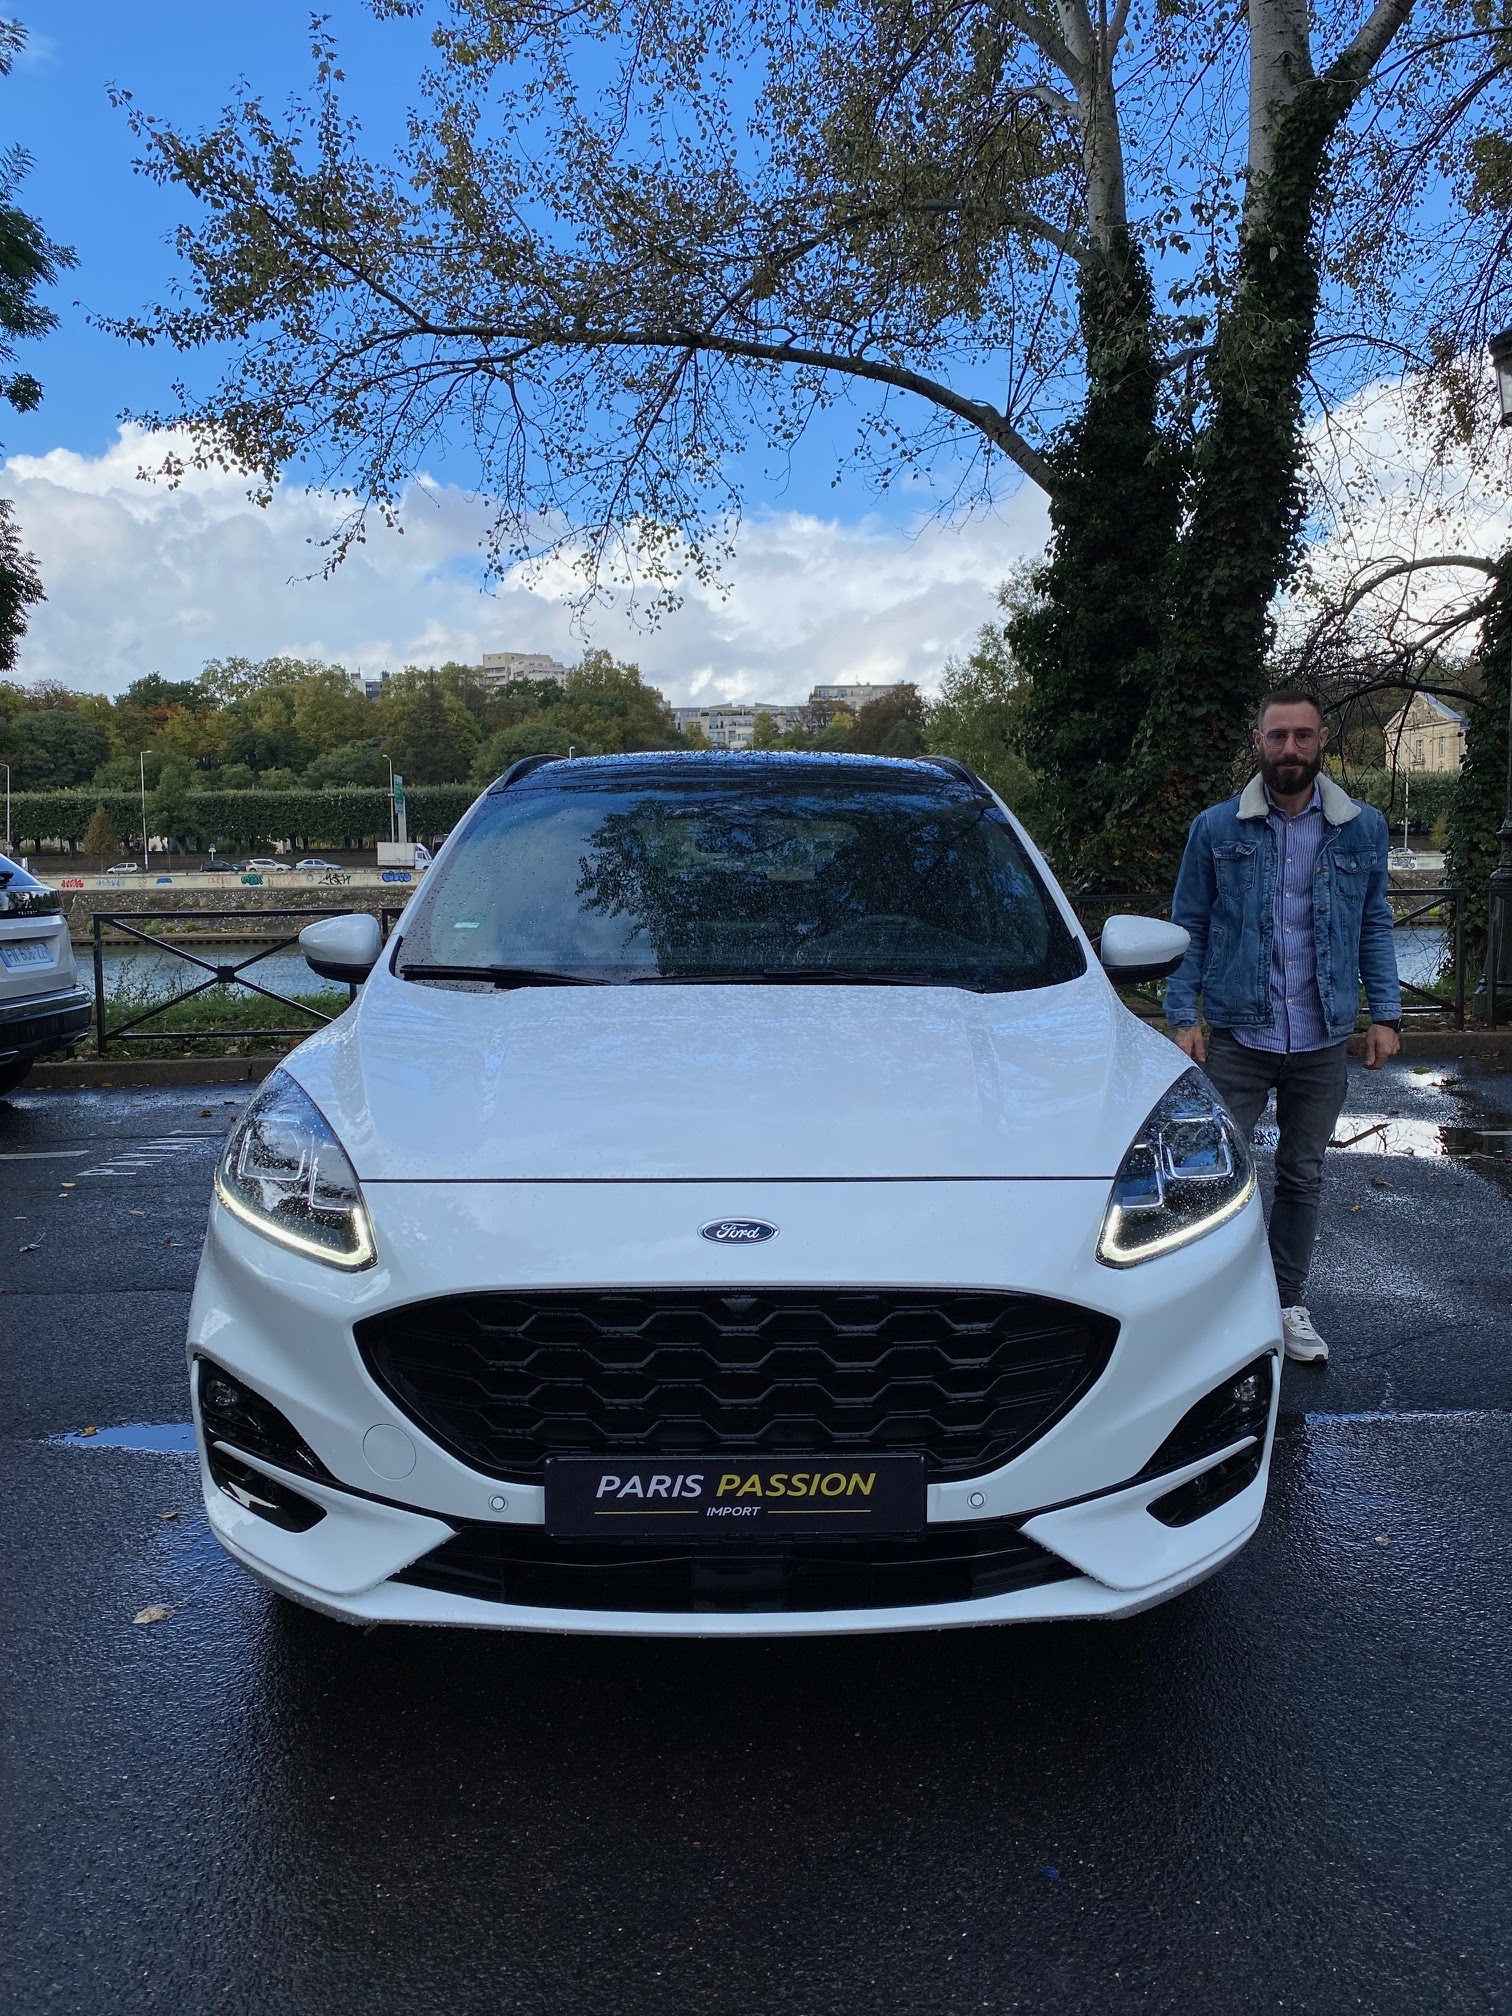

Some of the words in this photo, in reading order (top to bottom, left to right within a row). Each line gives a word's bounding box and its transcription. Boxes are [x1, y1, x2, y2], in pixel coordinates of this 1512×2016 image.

[716, 1222, 760, 1238] Ford
[595, 1474, 704, 1498] PARIS
[716, 1472, 876, 1497] PASSION
[706, 1506, 761, 1516] IMPORT
